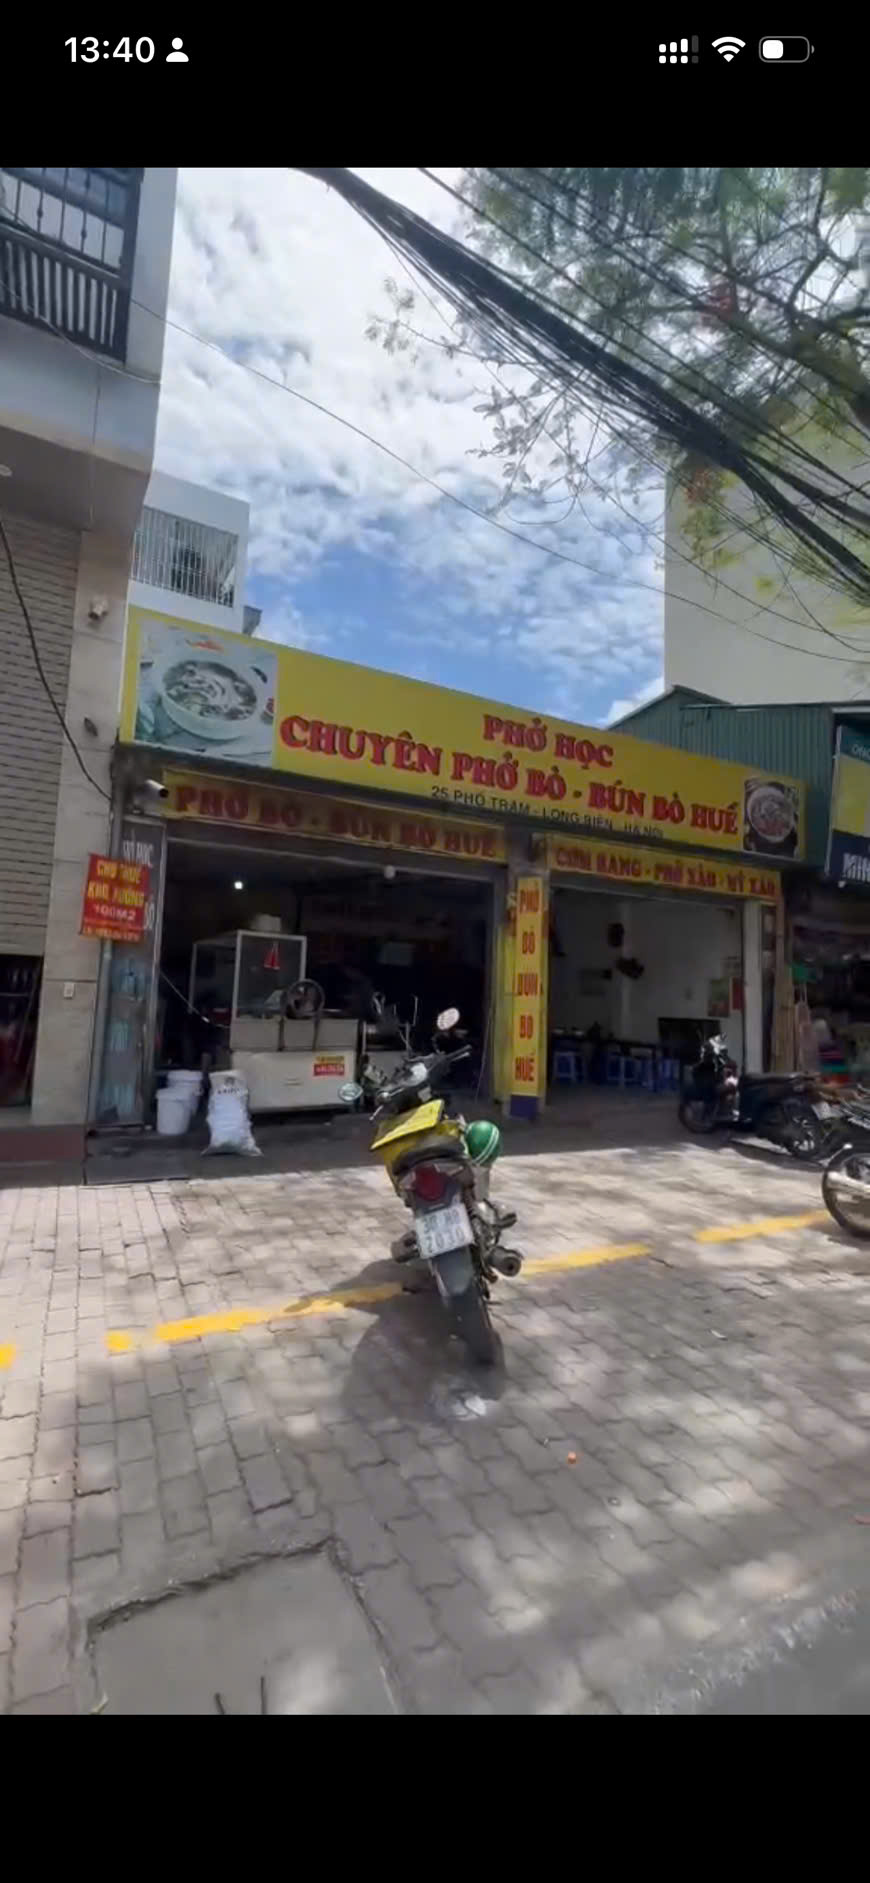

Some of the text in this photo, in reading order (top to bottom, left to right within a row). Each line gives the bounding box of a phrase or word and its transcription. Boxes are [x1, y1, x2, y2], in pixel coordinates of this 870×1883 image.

[483, 714, 614, 770] PHỞ HỌC
[279, 715, 443, 776] CHUYÊN
[450, 751, 519, 790] PHỞ
[525, 765, 566, 800] BÒ
[588, 779, 646, 817] BÚN
[651, 792, 685, 825] BÒ
[690, 801, 739, 835] HUẾ
[431, 785, 449, 799] 25
